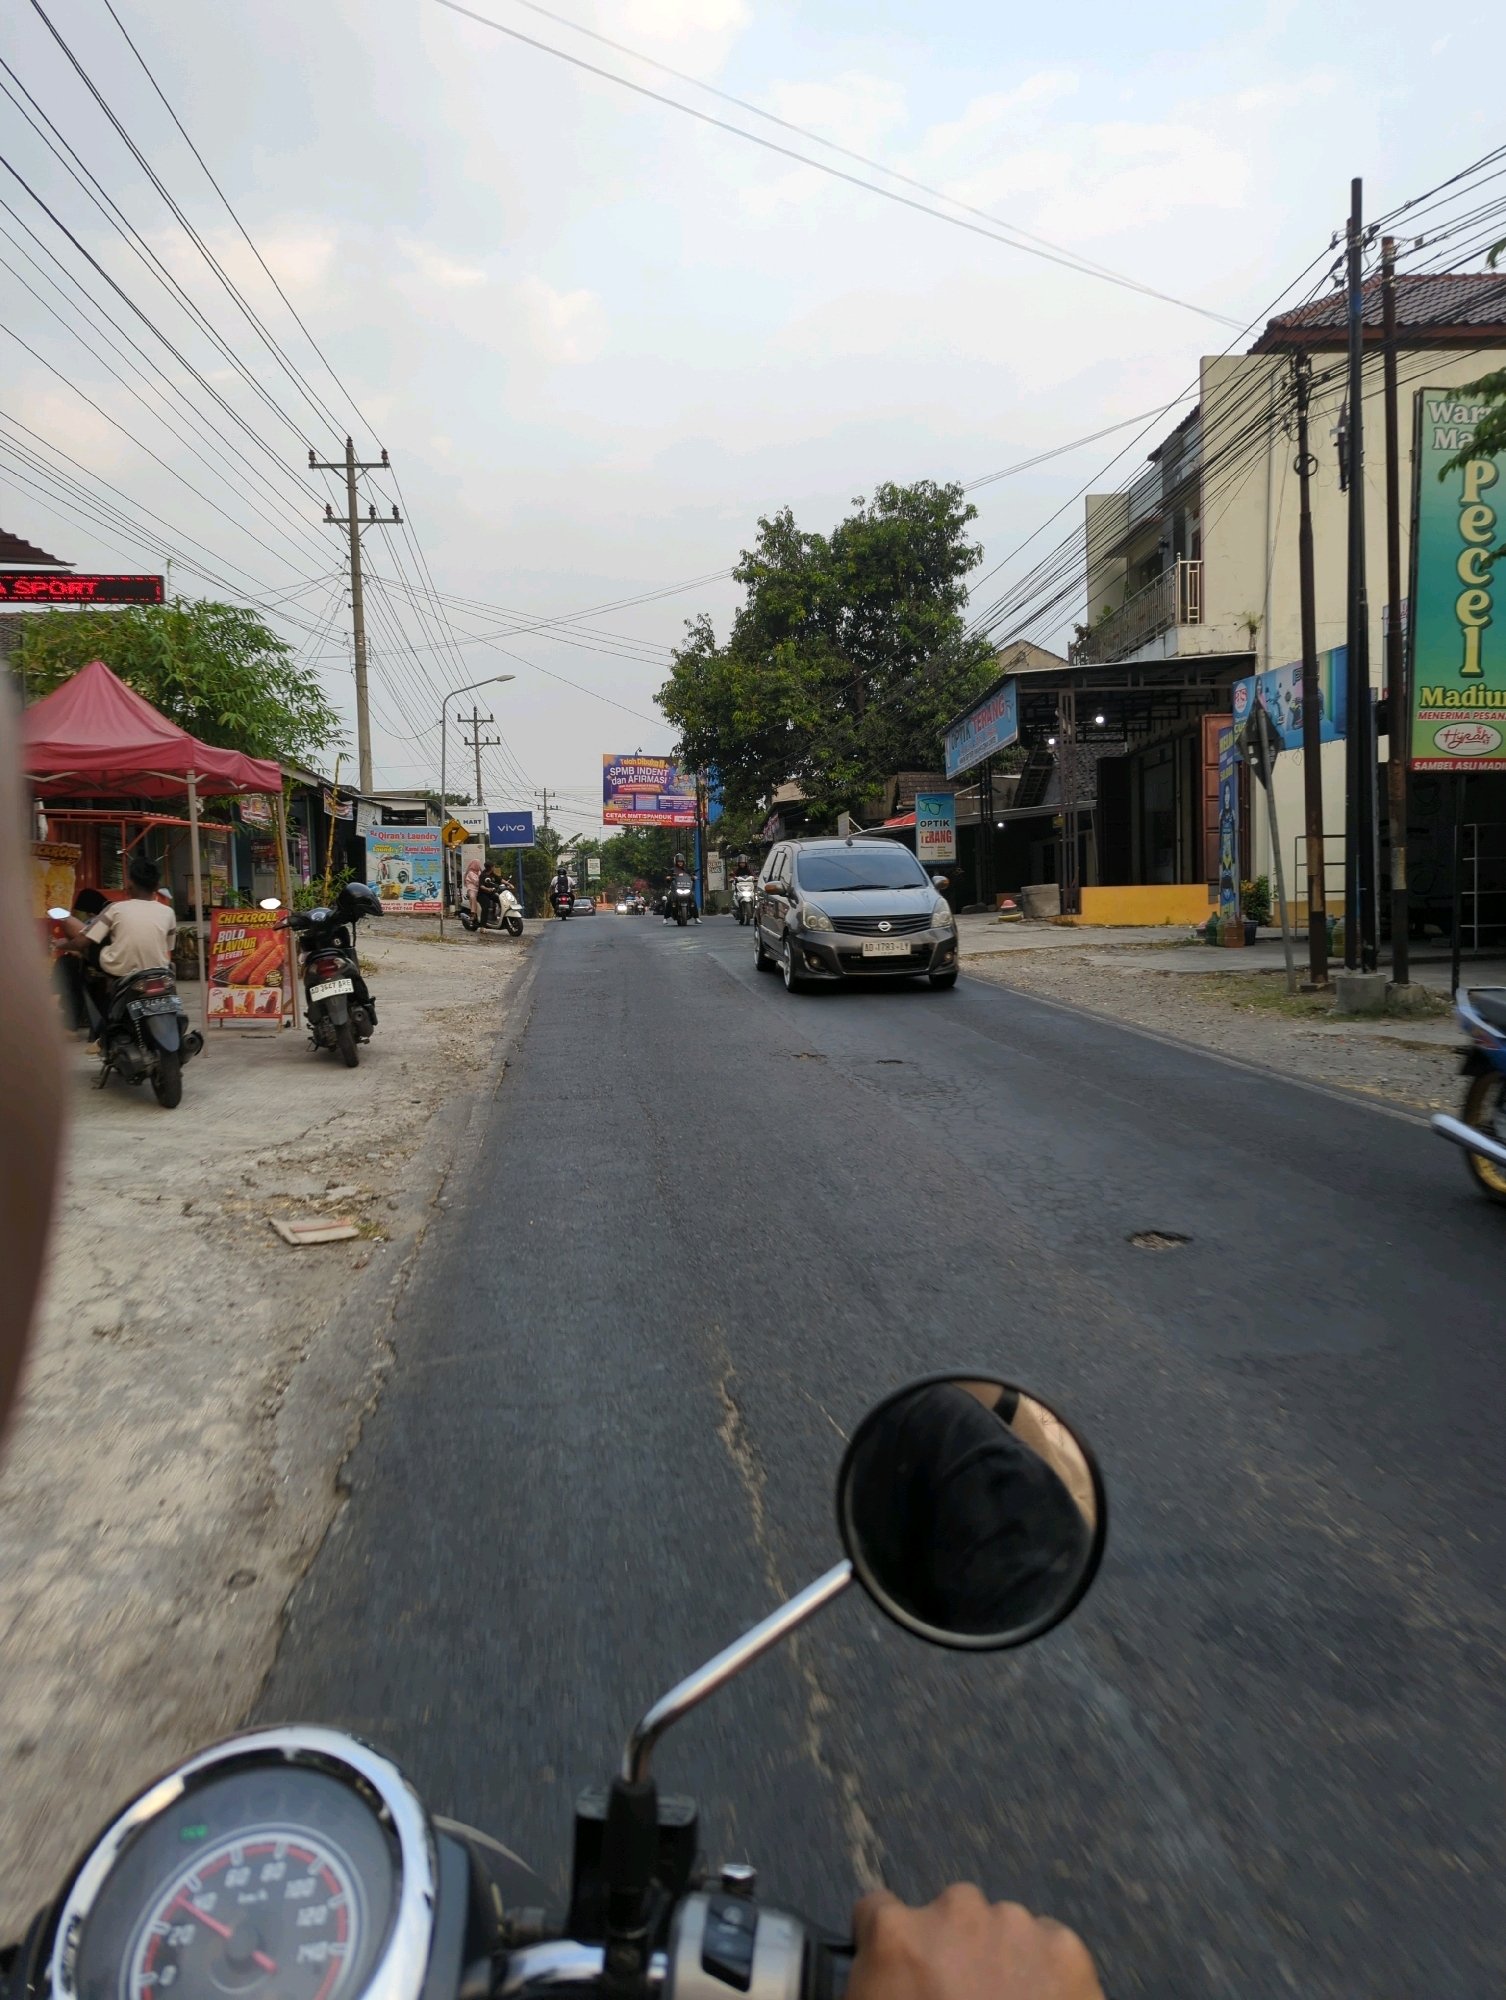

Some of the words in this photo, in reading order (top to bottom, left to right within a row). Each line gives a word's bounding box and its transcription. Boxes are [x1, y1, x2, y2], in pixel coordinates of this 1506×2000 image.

[1427, 402, 1494, 424] War
[1455, 459, 1499, 678] Pecel
[14, 580, 98, 595] SPORT
[1419, 683, 1506, 708] Madiu
[972, 693, 1005, 735] TERANG
[1418, 711, 1470, 720] MENERIMA
[1473, 711, 1506, 720] PESAN
[610, 766, 635, 776] SPMB
[637, 767, 669, 777] INDENT
[1414, 761, 1454, 771] SAMBEL
[1455, 761, 1477, 771] ASLI
[1478, 761, 1506, 771] MADI
[611, 776, 626, 785] dan
[628, 775, 667, 784] AFIRMASI
[920, 820, 950, 828] OPTIK
[378, 831, 405, 840] Qiran's
[407, 832, 438, 842] Laundry
[920, 829, 952, 843] TERANG
[217, 912, 278, 925] CHICKROLL
[217, 929, 246, 943] BOLD
[212, 937, 257, 955] FLAVOUR
[225, 950, 243, 960] EVERY
